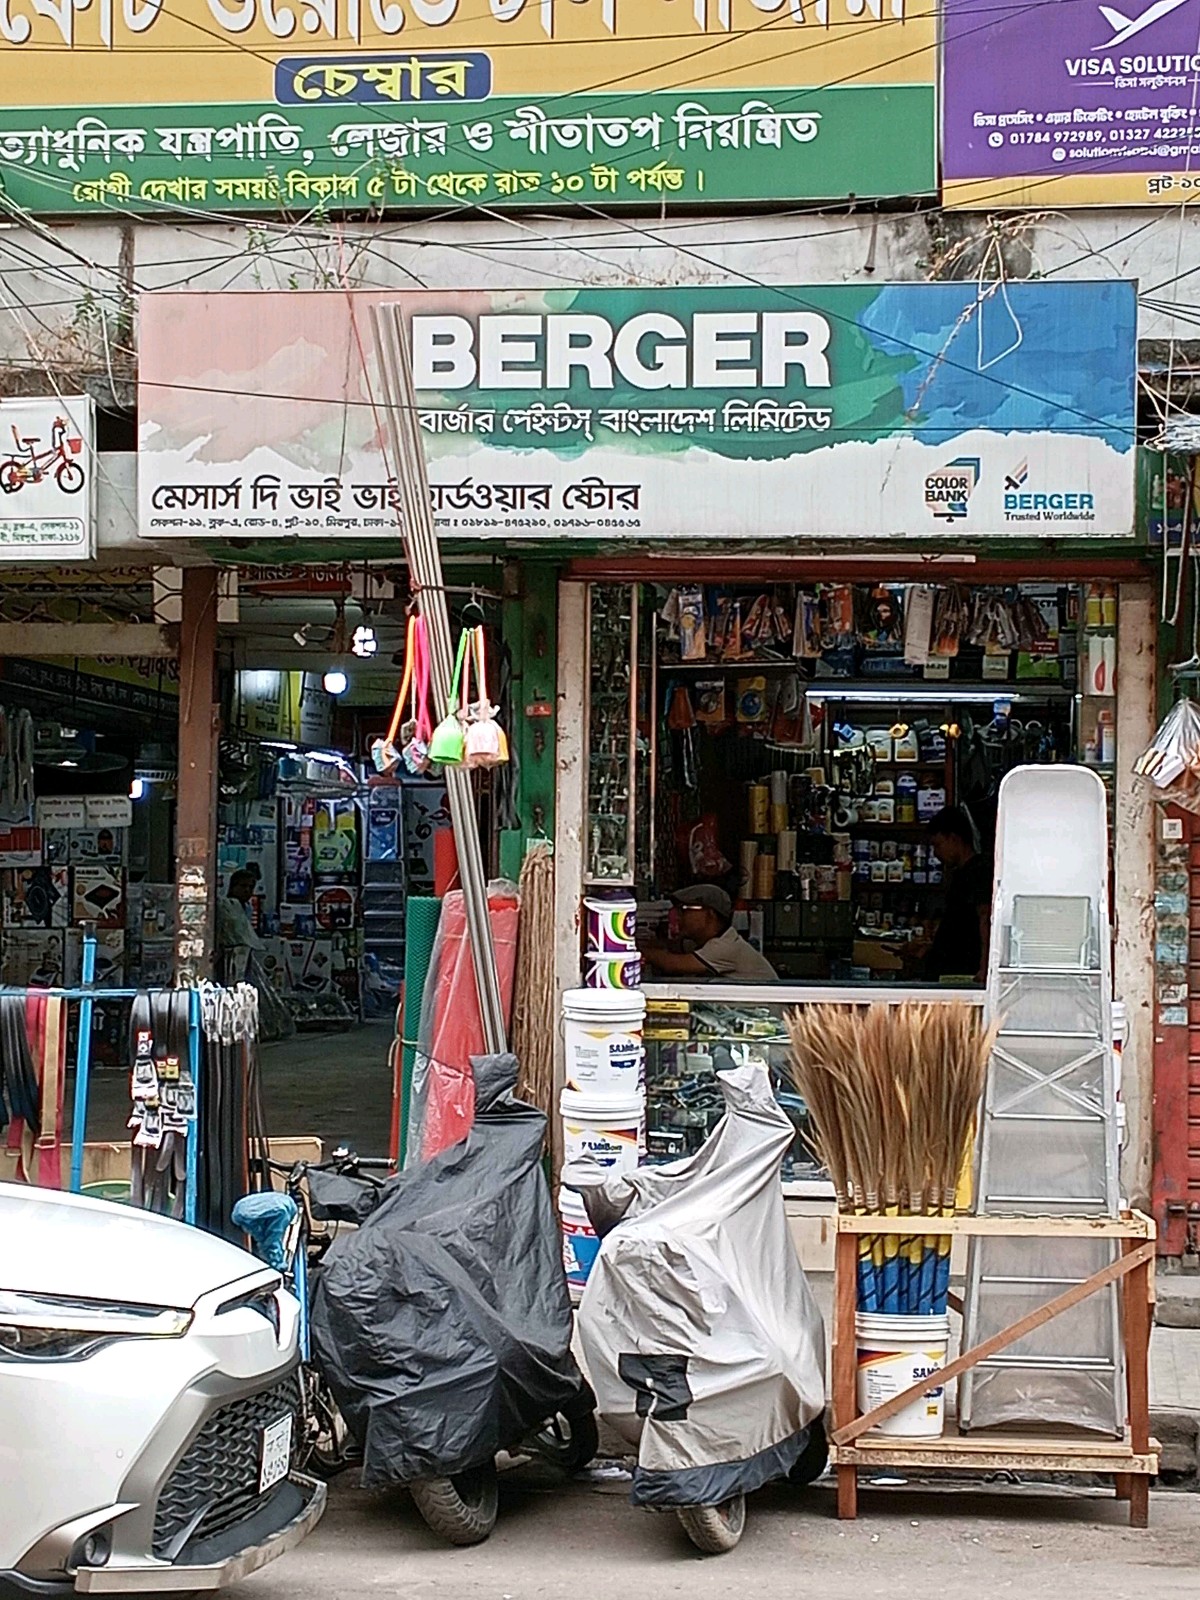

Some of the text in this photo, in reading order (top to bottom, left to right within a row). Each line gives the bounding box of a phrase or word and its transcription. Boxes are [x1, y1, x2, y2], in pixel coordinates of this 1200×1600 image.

[294, 57, 474, 101] চেম্বার
[1065, 58, 1115, 76] VISA
[328, 117, 449, 158] লেজার
[462, 122, 493, 152] ও
[503, 105, 664, 155] শীতাতপ
[672, 100, 822, 151] নিয়ন্ত্রিত
[1010, 132, 1050, 144] 01784
[1109, 129, 1150, 141] 01327
[73, 173, 131, 203] রোগী
[141, 177, 208, 202] দেখার
[285, 170, 359, 199] বিকাল
[391, 169, 416, 197] টা
[427, 171, 488, 196] থেকে
[493, 170, 543, 195] রাত
[551, 171, 584, 194] ১০
[590, 164, 618, 192] টা
[626, 161, 685, 193] পর্যন্ত
[411, 312, 832, 390] BERGER
[418, 403, 496, 433] বার্জার
[598, 409, 716, 436] বাংলাদেশ
[722, 400, 832, 432] লিমিটেড
[152, 477, 242, 510] মেসার্স
[250, 475, 280, 510] দি
[288, 477, 343, 512] ভাই
[428, 476, 553, 513] ার্ডওয়ার
[562, 476, 641, 510] ষ্টোর
[925, 477, 968, 490] COLOR
[925, 490, 968, 502] BANK
[1004, 494, 1094, 509] BERGER
[1004, 511, 1096, 521] Trusted Worldwide
